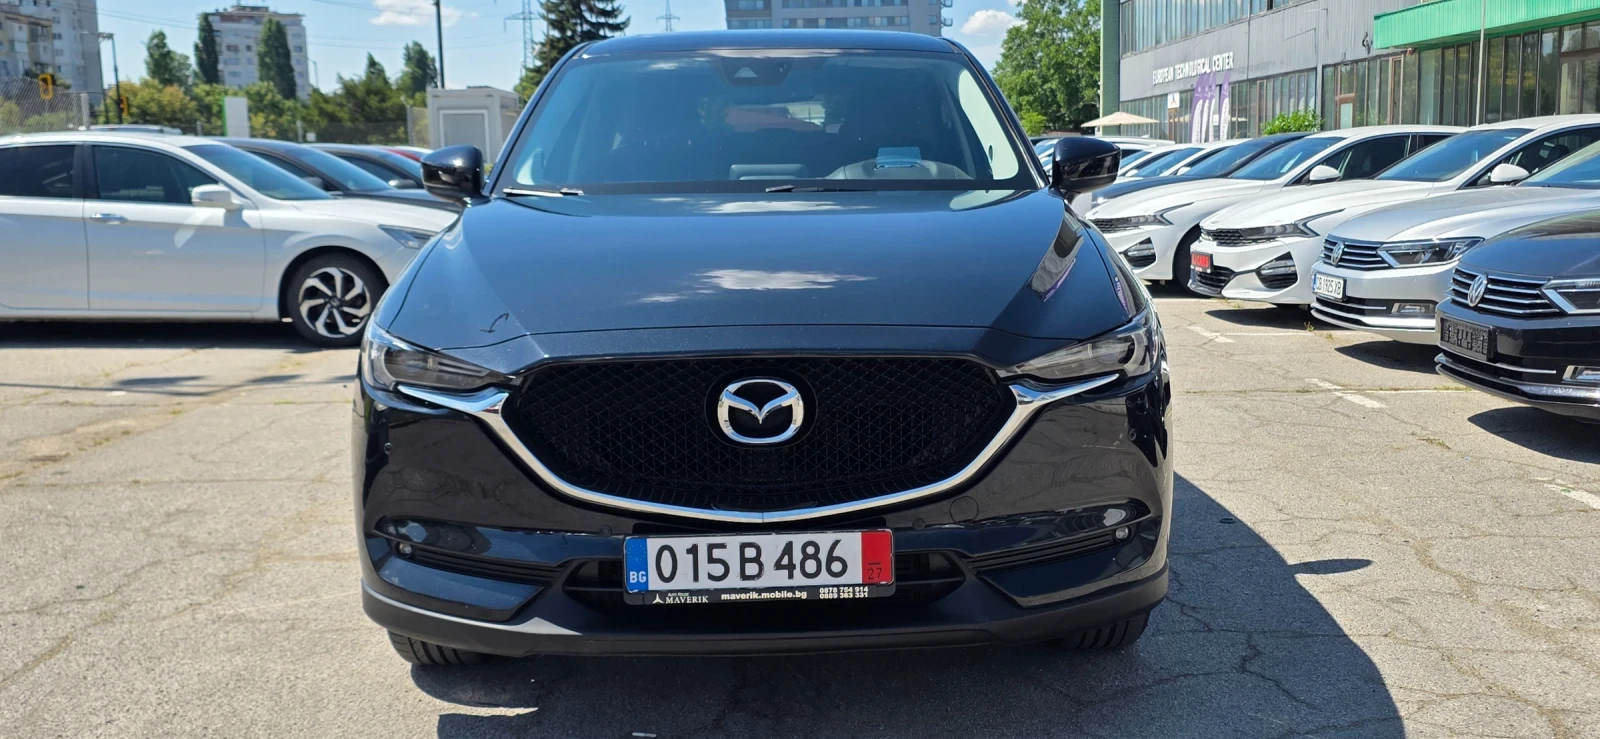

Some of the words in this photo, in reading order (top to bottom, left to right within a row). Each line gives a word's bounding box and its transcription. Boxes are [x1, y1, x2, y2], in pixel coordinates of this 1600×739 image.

[1152, 66, 1174, 85] EUROPEAN
[1174, 57, 1211, 80] TECHNOLOGICAL
[1212, 51, 1234, 72] CENTER
[655, 542, 730, 583] 015
[739, 541, 764, 582] B
[774, 539, 848, 580] 486
[629, 570, 647, 584] BG
[867, 567, 883, 580] 27
[665, 595, 709, 604] MAVERIK
[720, 590, 808, 600] maverik.mobile.bg
